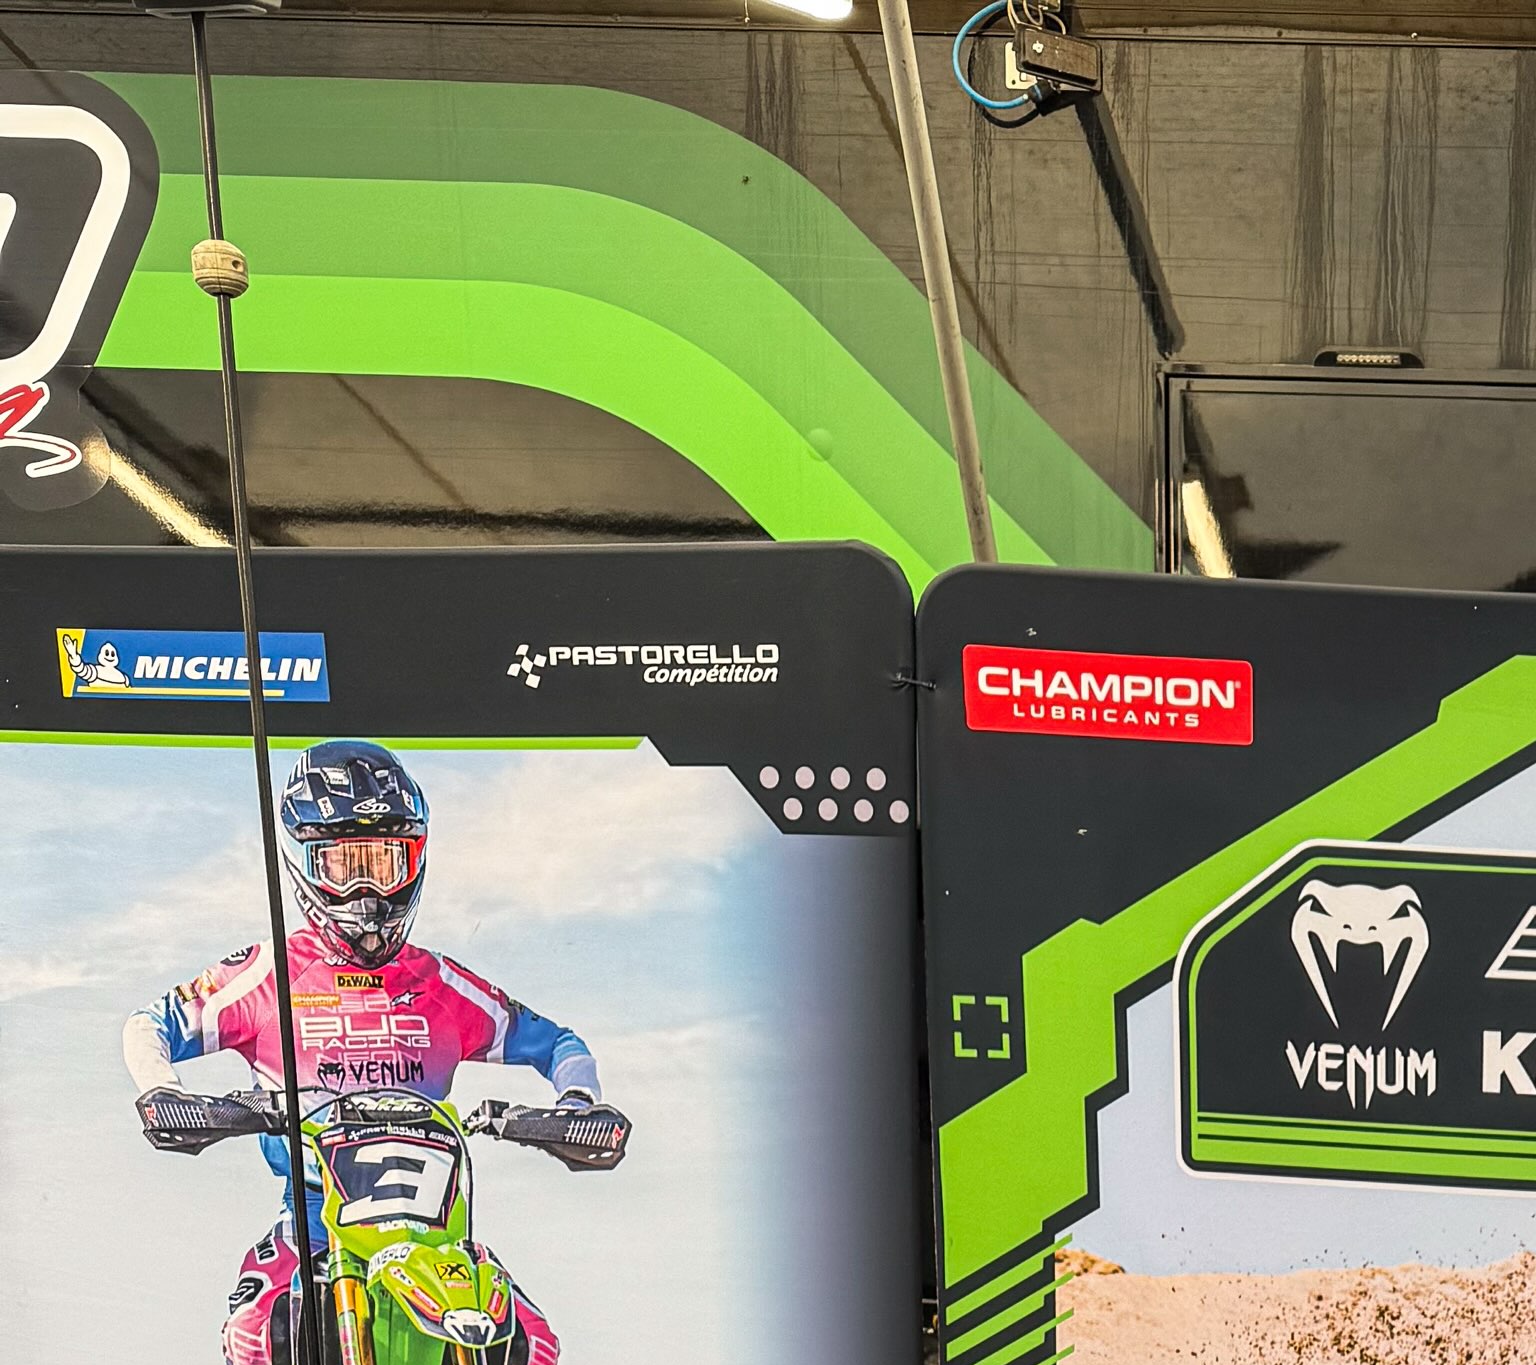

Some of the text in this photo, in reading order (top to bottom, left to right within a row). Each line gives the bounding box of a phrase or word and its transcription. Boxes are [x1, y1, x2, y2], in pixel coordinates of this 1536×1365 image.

[549, 644, 779, 665] PASTORELLO
[134, 656, 322, 682] MICHELIN
[643, 664, 778, 687] Compétition
[977, 666, 1236, 709] CHAMPION
[1013, 703, 1200, 727] LUBRICANTS
[300, 1014, 430, 1038] BUD
[302, 1036, 431, 1050] RACING
[350, 1060, 424, 1086] VENUM
[1285, 1040, 1437, 1110] VENUM
[340, 1142, 455, 1225] 3
